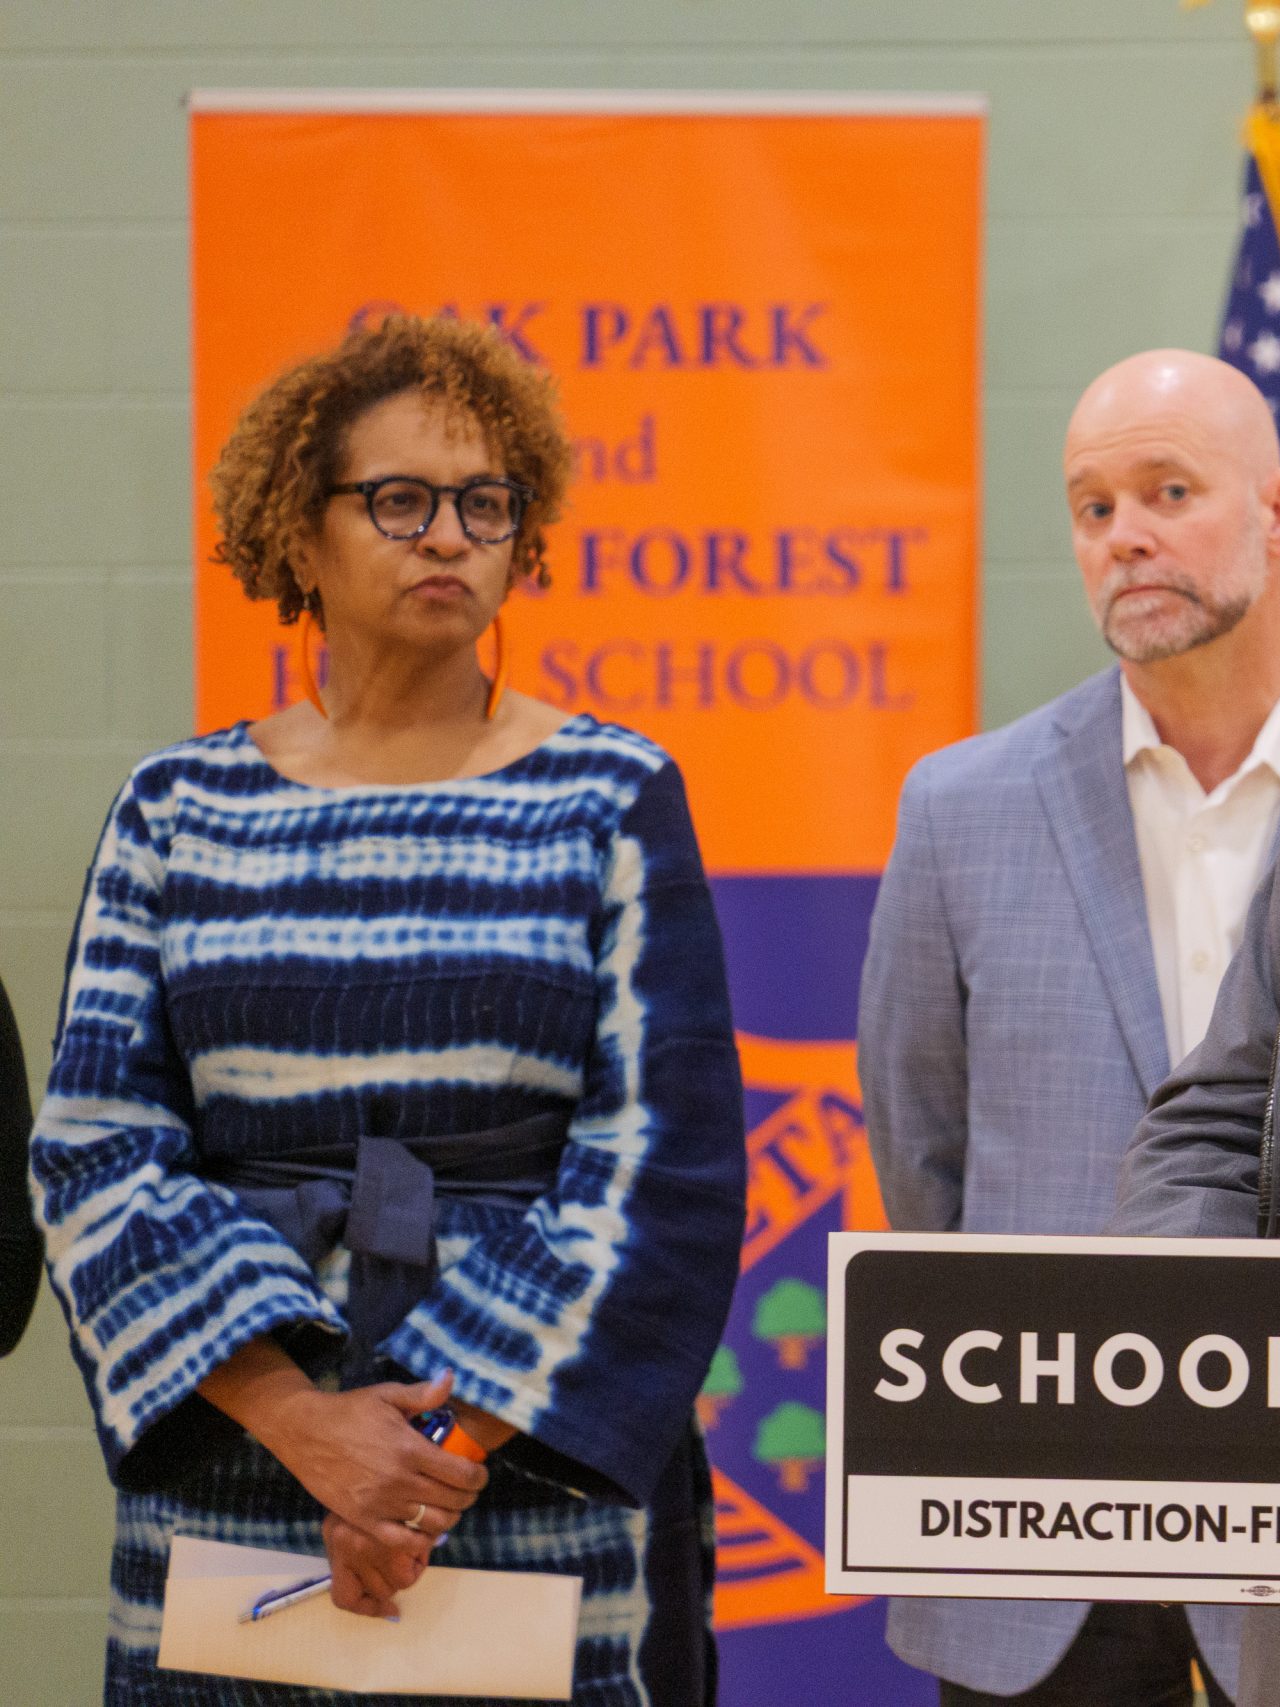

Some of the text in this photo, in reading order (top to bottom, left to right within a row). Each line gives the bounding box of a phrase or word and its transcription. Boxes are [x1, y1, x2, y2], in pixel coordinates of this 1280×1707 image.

[578, 301, 830, 369] PARK
[568, 412, 656, 480] nd
[581, 527, 928, 597] FOREST
[538, 638, 916, 712] SCHOOL
